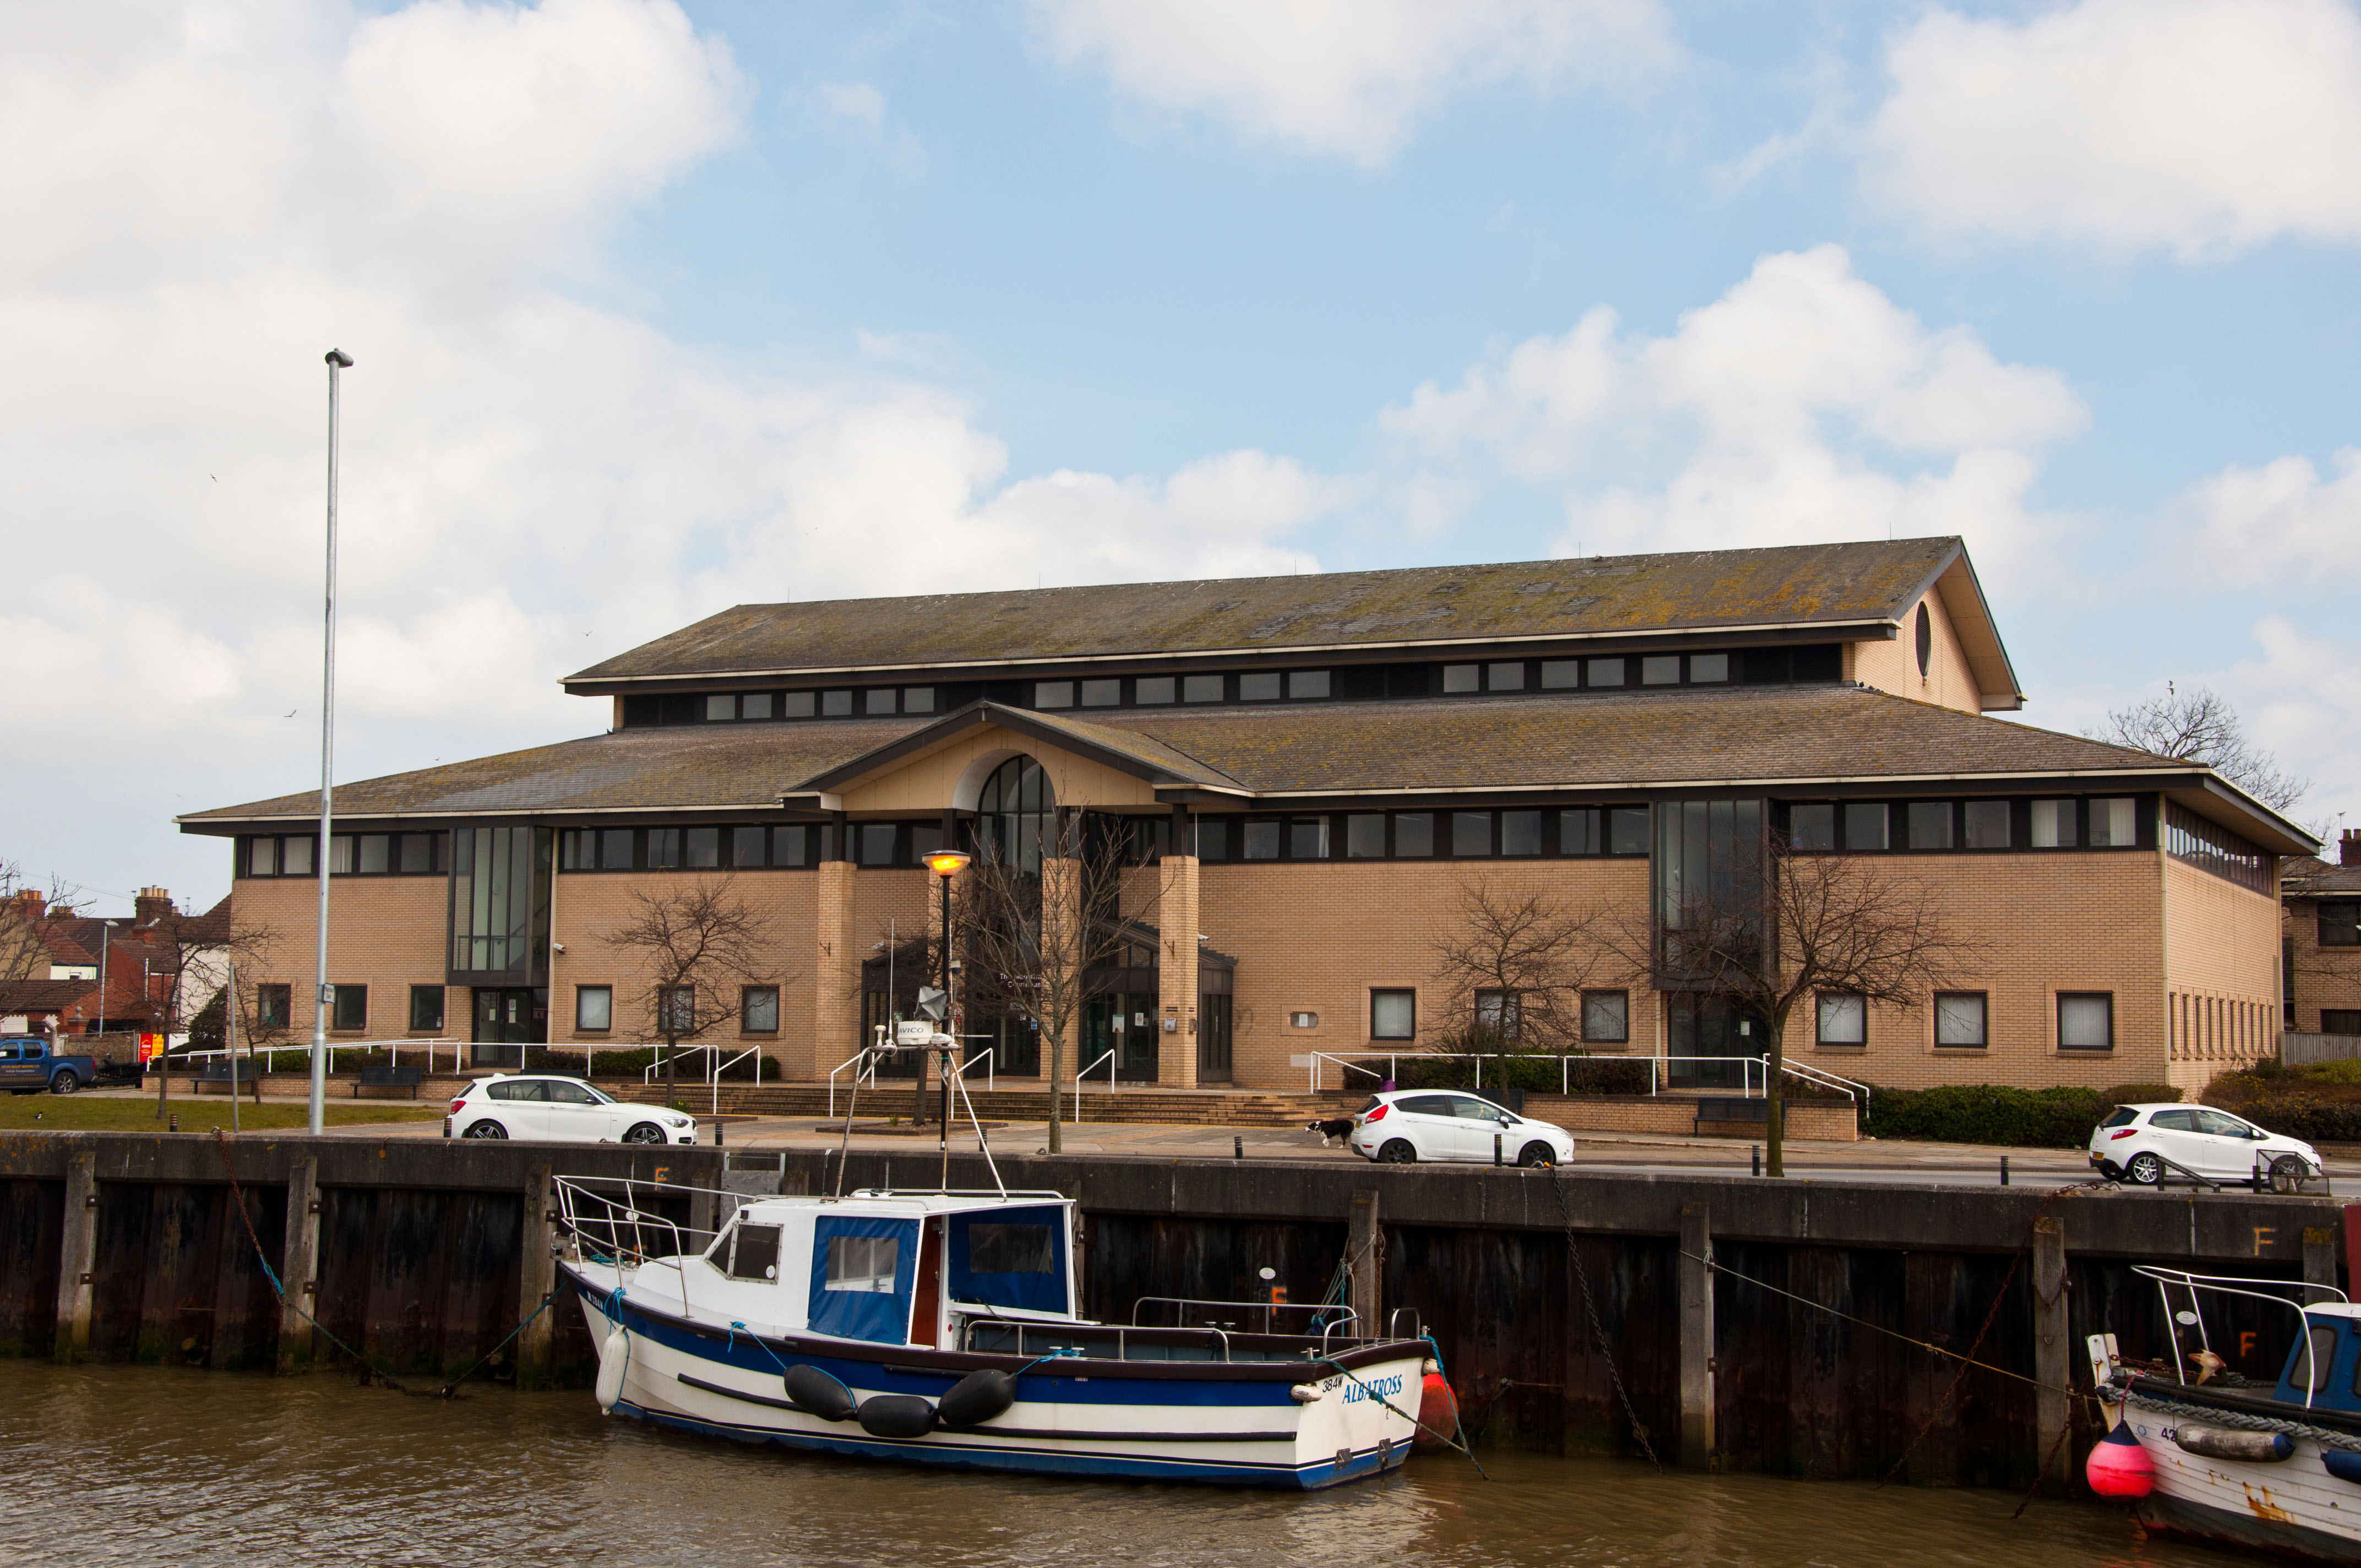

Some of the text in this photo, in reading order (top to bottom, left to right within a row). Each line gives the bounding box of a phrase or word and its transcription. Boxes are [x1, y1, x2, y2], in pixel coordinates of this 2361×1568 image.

[2254, 1228, 2276, 1256] F
[2240, 1332, 2256, 1358] F
[1322, 1375, 1344, 1393] 384W
[1341, 1374, 1402, 1404] ALBATROSS
